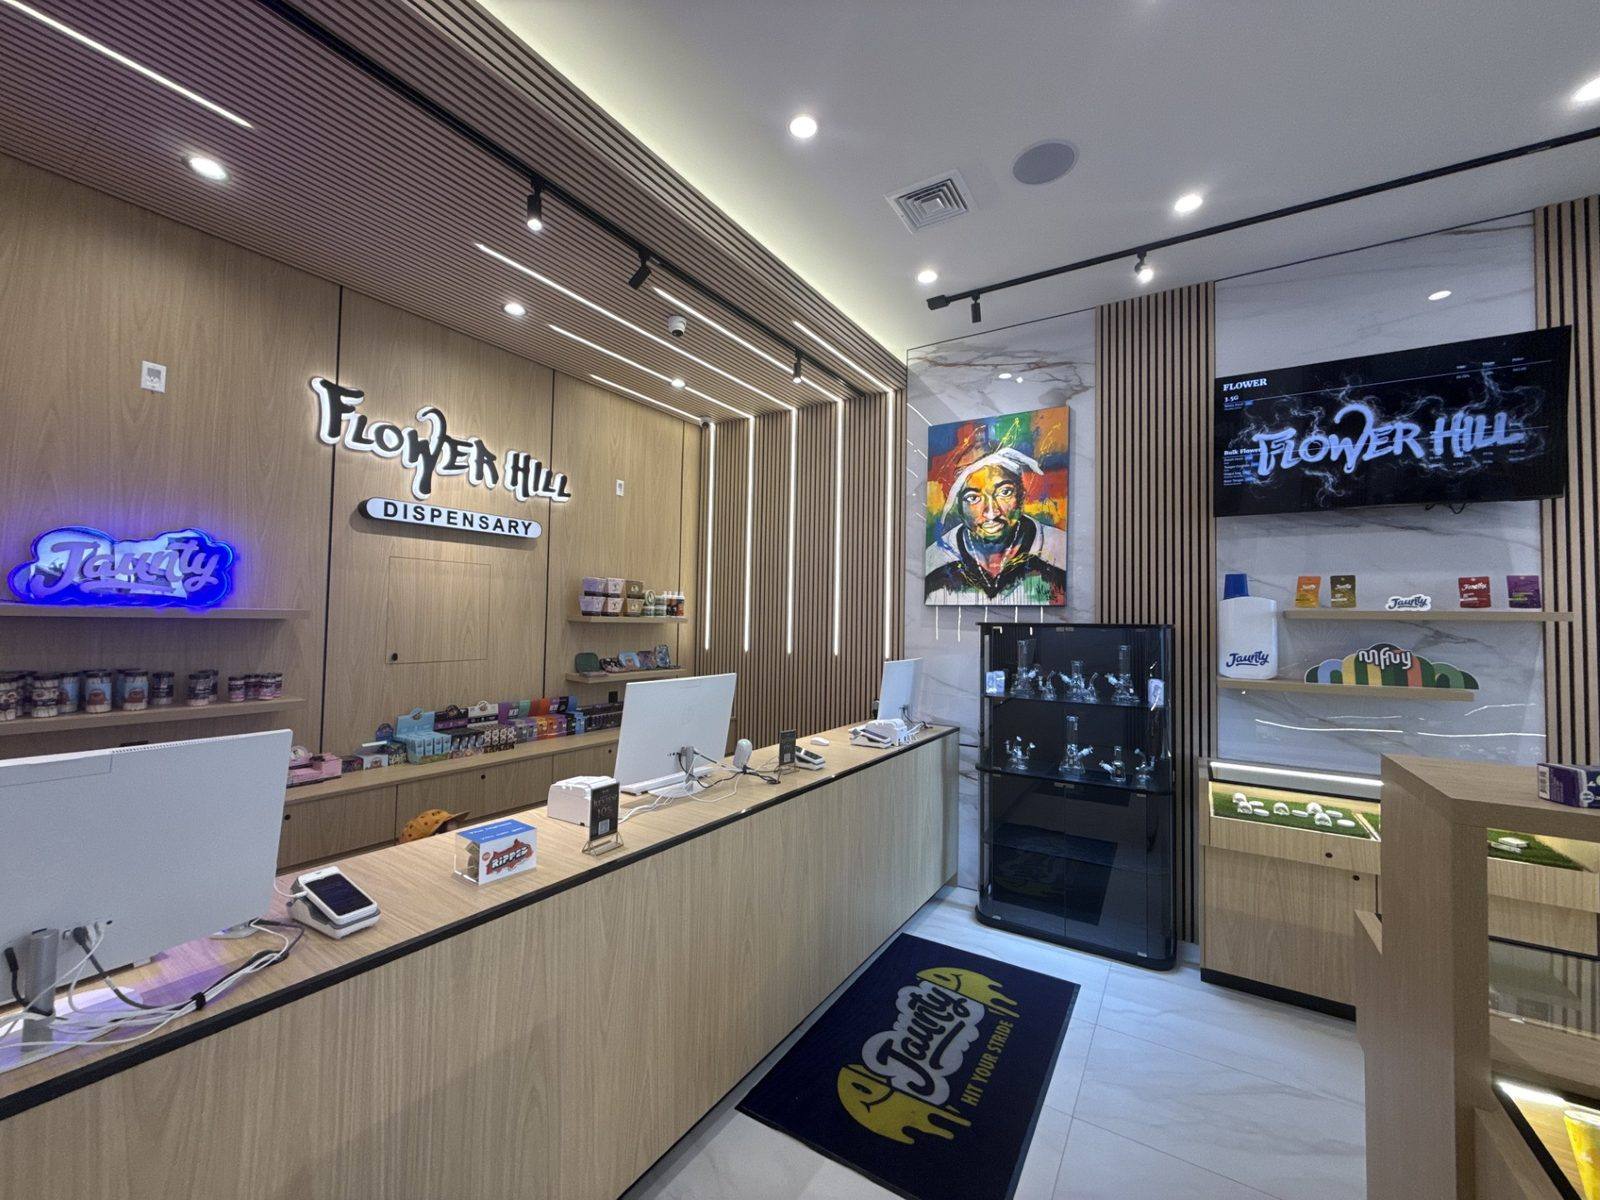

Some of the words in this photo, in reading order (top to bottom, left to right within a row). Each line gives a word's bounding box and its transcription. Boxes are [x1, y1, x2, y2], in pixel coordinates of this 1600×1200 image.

[1223, 378, 1268, 391] FLOWER
[313, 378, 499, 498] FLOWER
[504, 451, 571, 501] HILL
[1252, 403, 1425, 476] FLOWER
[1429, 411, 1526, 458] HILL
[383, 501, 532, 536] DISPENSARY
[29, 541, 219, 599] Jaunty
[1388, 596, 1428, 609] Jaunty
[1226, 650, 1270, 668] Jaunty
[876, 987, 970, 1096] Jaunty
[987, 1020, 1015, 1054] STRIDE
[971, 1053, 999, 1084] YOUR
[960, 1083, 984, 1107] HIT
